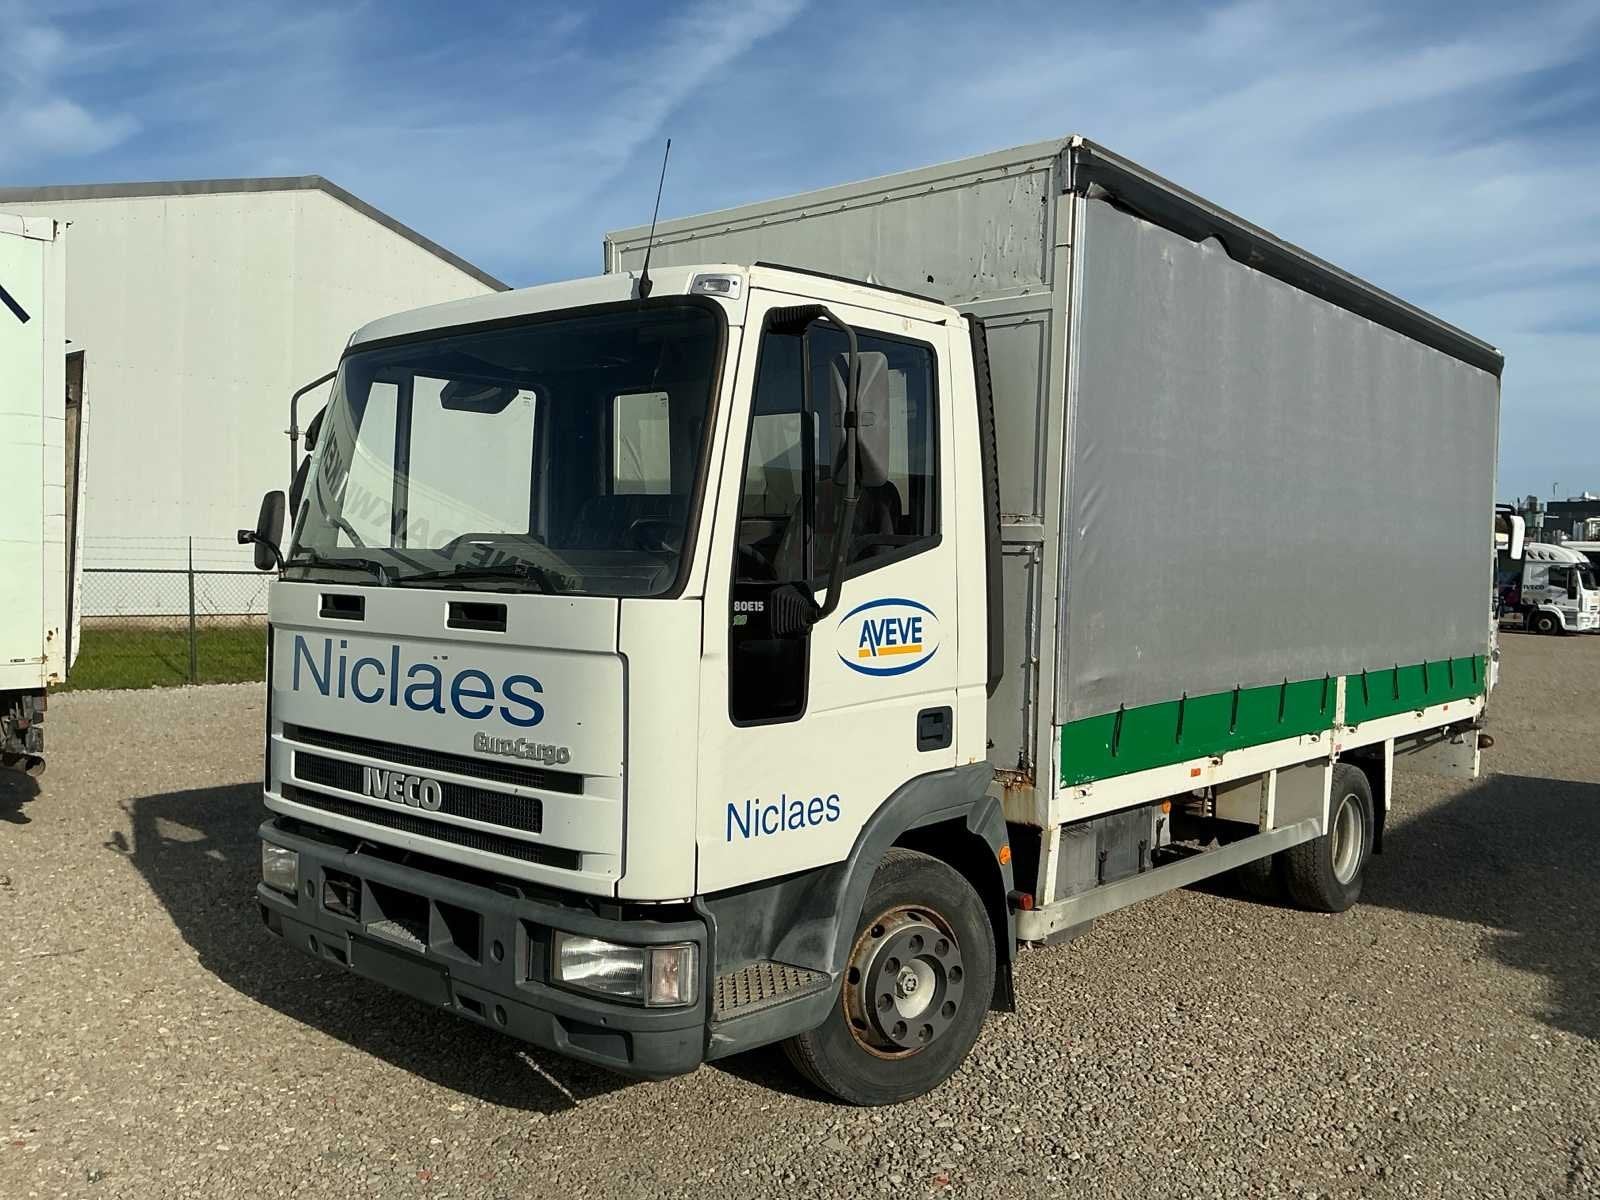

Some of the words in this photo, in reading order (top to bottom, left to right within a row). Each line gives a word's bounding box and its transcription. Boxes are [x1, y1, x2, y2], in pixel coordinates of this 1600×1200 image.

[733, 600, 764, 612] 80E15
[859, 616, 922, 656] AVEVE
[291, 634, 545, 728] Niclaes
[473, 731, 571, 766] EuroCargo
[362, 766, 442, 812] IVECO
[726, 792, 841, 842] Niclaes
